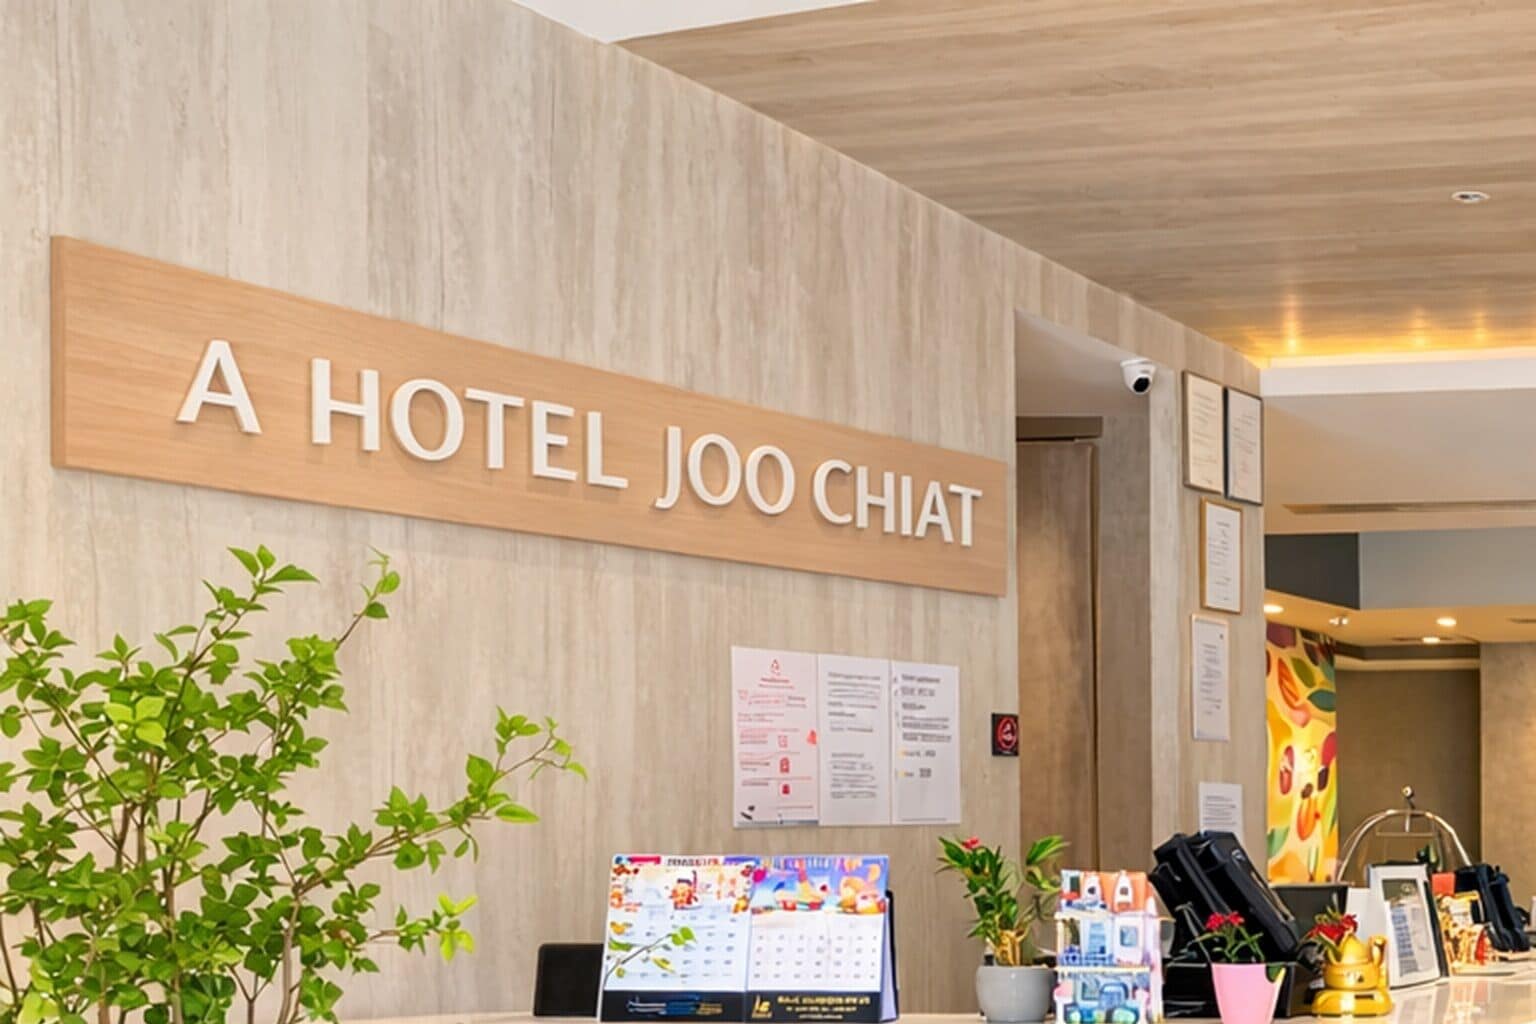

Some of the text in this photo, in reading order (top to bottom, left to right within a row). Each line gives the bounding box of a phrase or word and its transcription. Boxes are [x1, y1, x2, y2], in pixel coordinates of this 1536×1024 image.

[175, 339, 984, 547] A HOTEL JOO CHIAT
